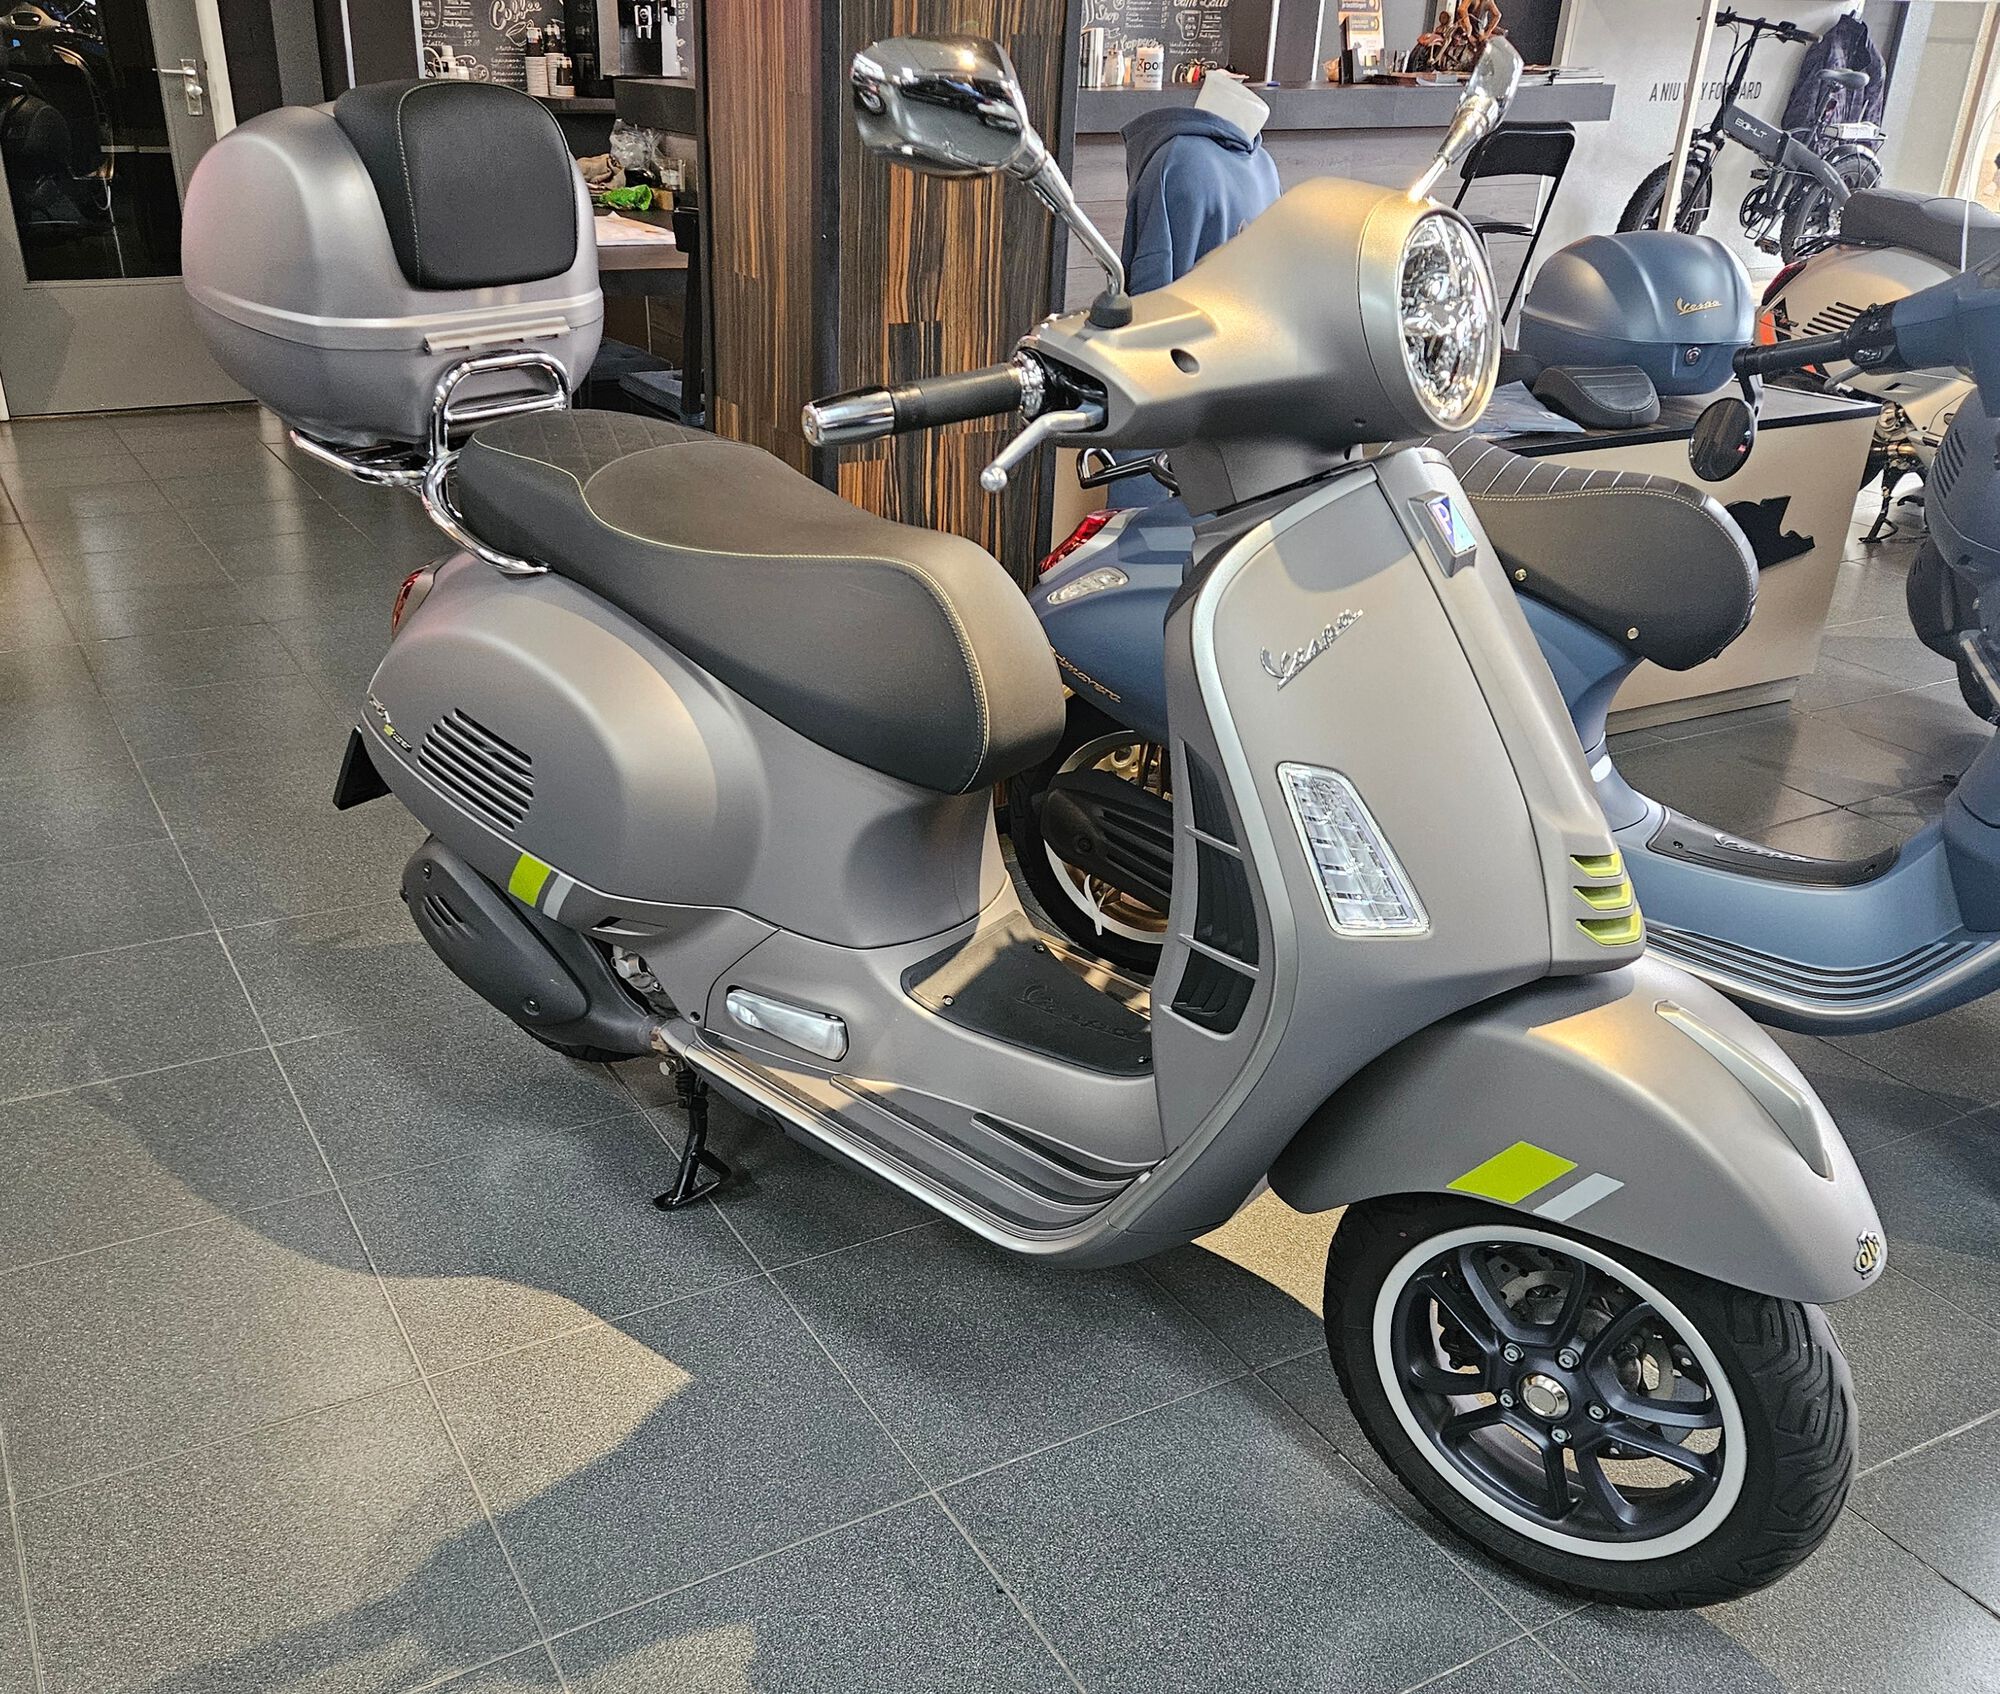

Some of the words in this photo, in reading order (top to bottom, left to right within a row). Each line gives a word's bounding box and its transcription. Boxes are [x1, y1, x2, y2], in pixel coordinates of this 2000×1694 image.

[1095, 5, 1120, 23] Shop
[1649, 83, 1658, 101] A
[1660, 82, 1681, 101] NIU
[1676, 297, 1723, 316] Vespa
[1259, 609, 1364, 692] Vespa
[1714, 832, 1815, 864] Vespa
